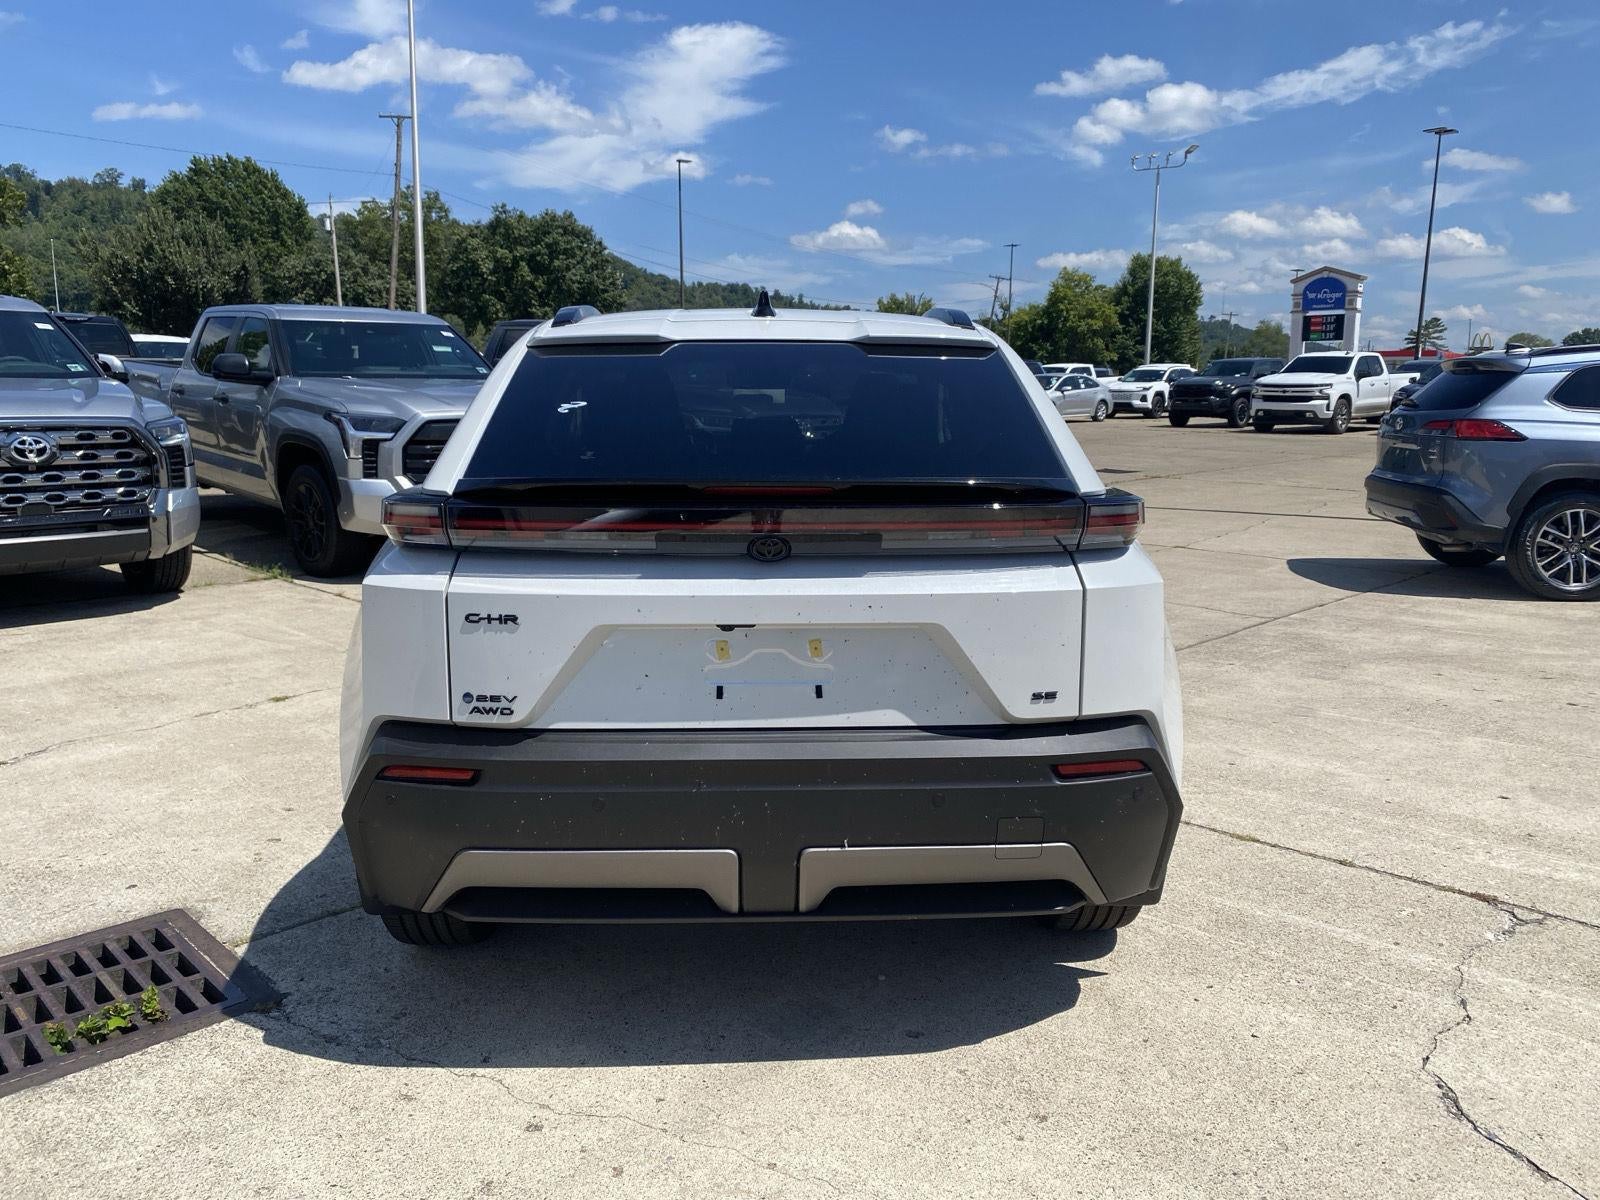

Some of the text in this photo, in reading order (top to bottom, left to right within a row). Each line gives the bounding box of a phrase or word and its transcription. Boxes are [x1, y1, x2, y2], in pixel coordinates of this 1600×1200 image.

[464, 612, 519, 626] C-HR
[1031, 690, 1059, 701] SE
[468, 705, 515, 716] AWD
